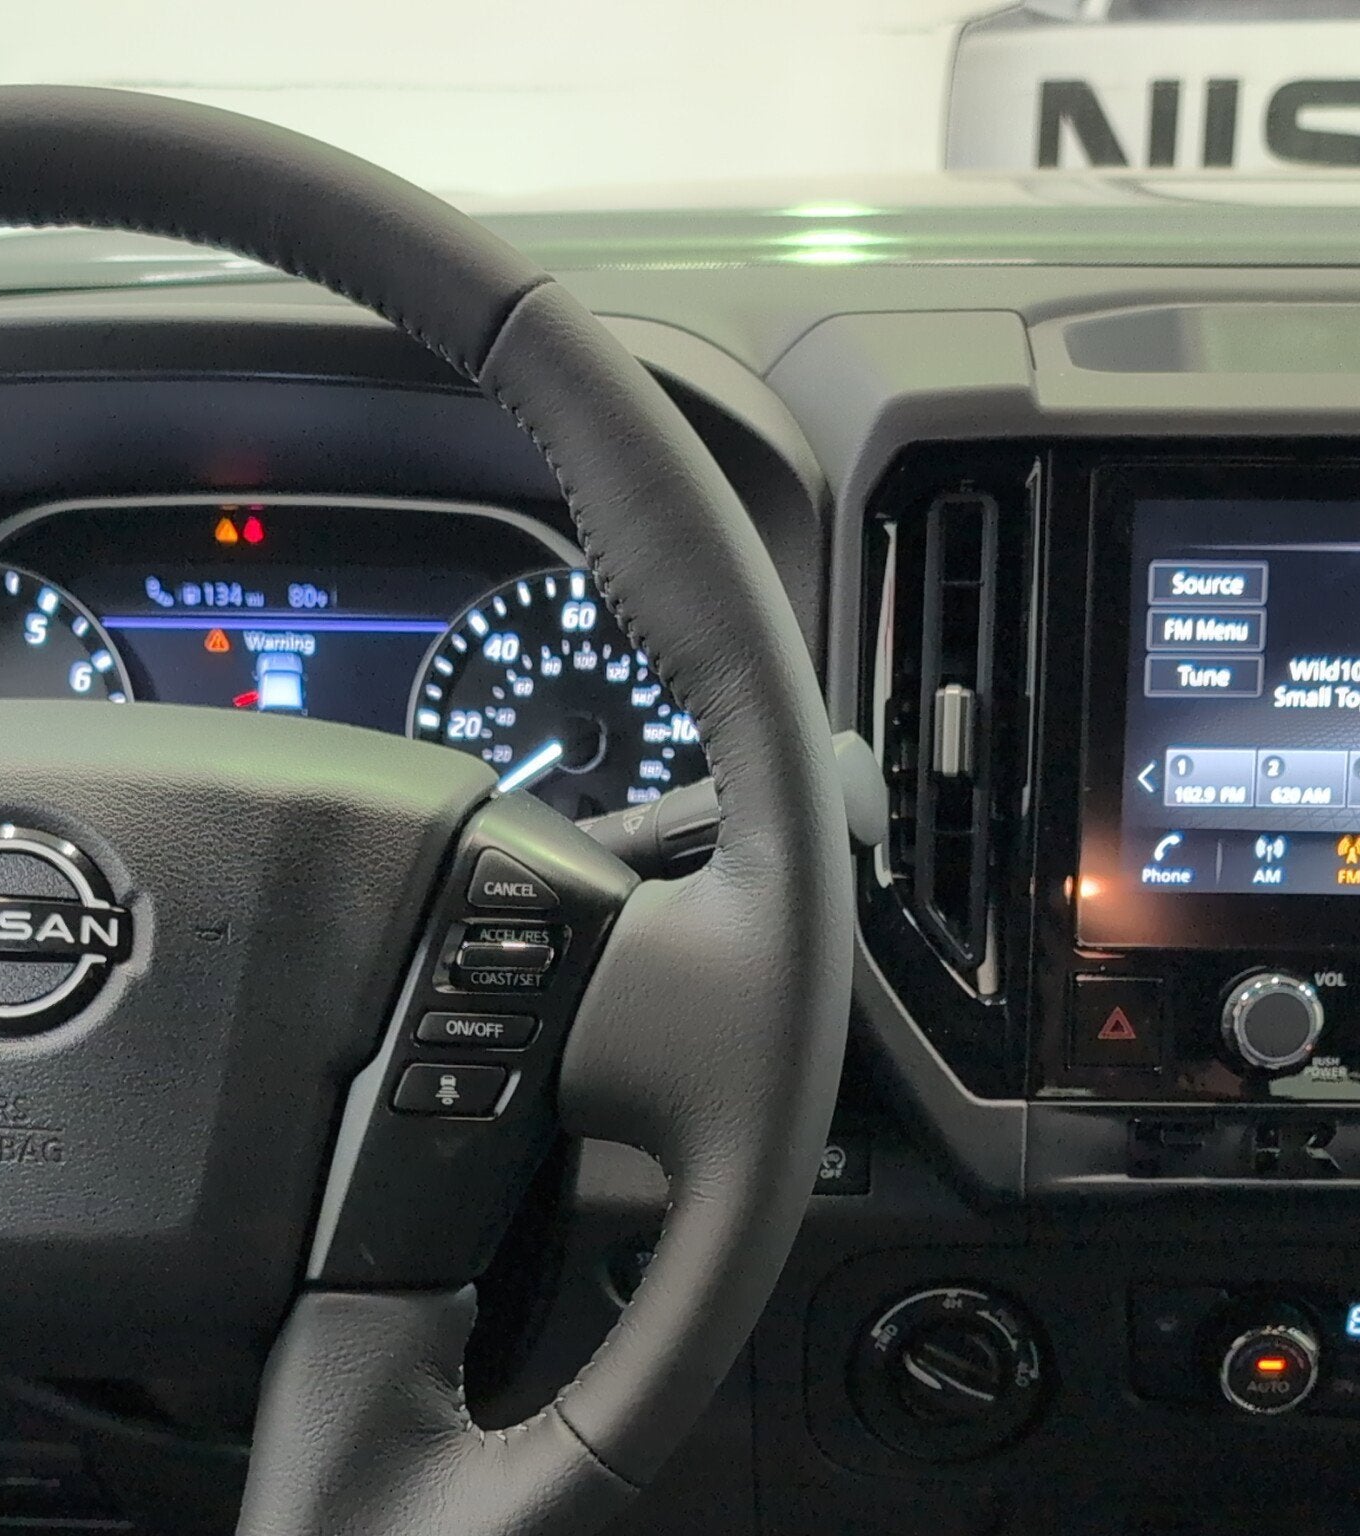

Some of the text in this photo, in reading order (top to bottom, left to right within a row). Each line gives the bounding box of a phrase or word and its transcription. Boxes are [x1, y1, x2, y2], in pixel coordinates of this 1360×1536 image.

[203, 581, 242, 606] 134
[1172, 569, 1245, 595] Source
[24, 612, 49, 645] 5
[561, 601, 597, 633] 60
[1164, 617, 1249, 641] FM Menu
[243, 631, 316, 656] Warning
[484, 633, 520, 662] 40
[69, 660, 94, 693] 6
[1177, 662, 1231, 687] Tune
[1274, 686, 1333, 708] Small
[447, 710, 483, 739] 20
[671, 712, 700, 743] 10
[1177, 758, 1187, 776] 1
[1267, 760, 1281, 778] 2
[1301, 787, 1331, 804] AM
[1142, 867, 1192, 884] Phone
[1252, 868, 1283, 884] AM
[483, 881, 538, 898] CANCEL
[480, 928, 550, 944] ACCEL/RES
[470, 971, 542, 987] COAST/SET
[1314, 972, 1347, 988] VOL
[445, 1019, 505, 1039] ON/OFF
